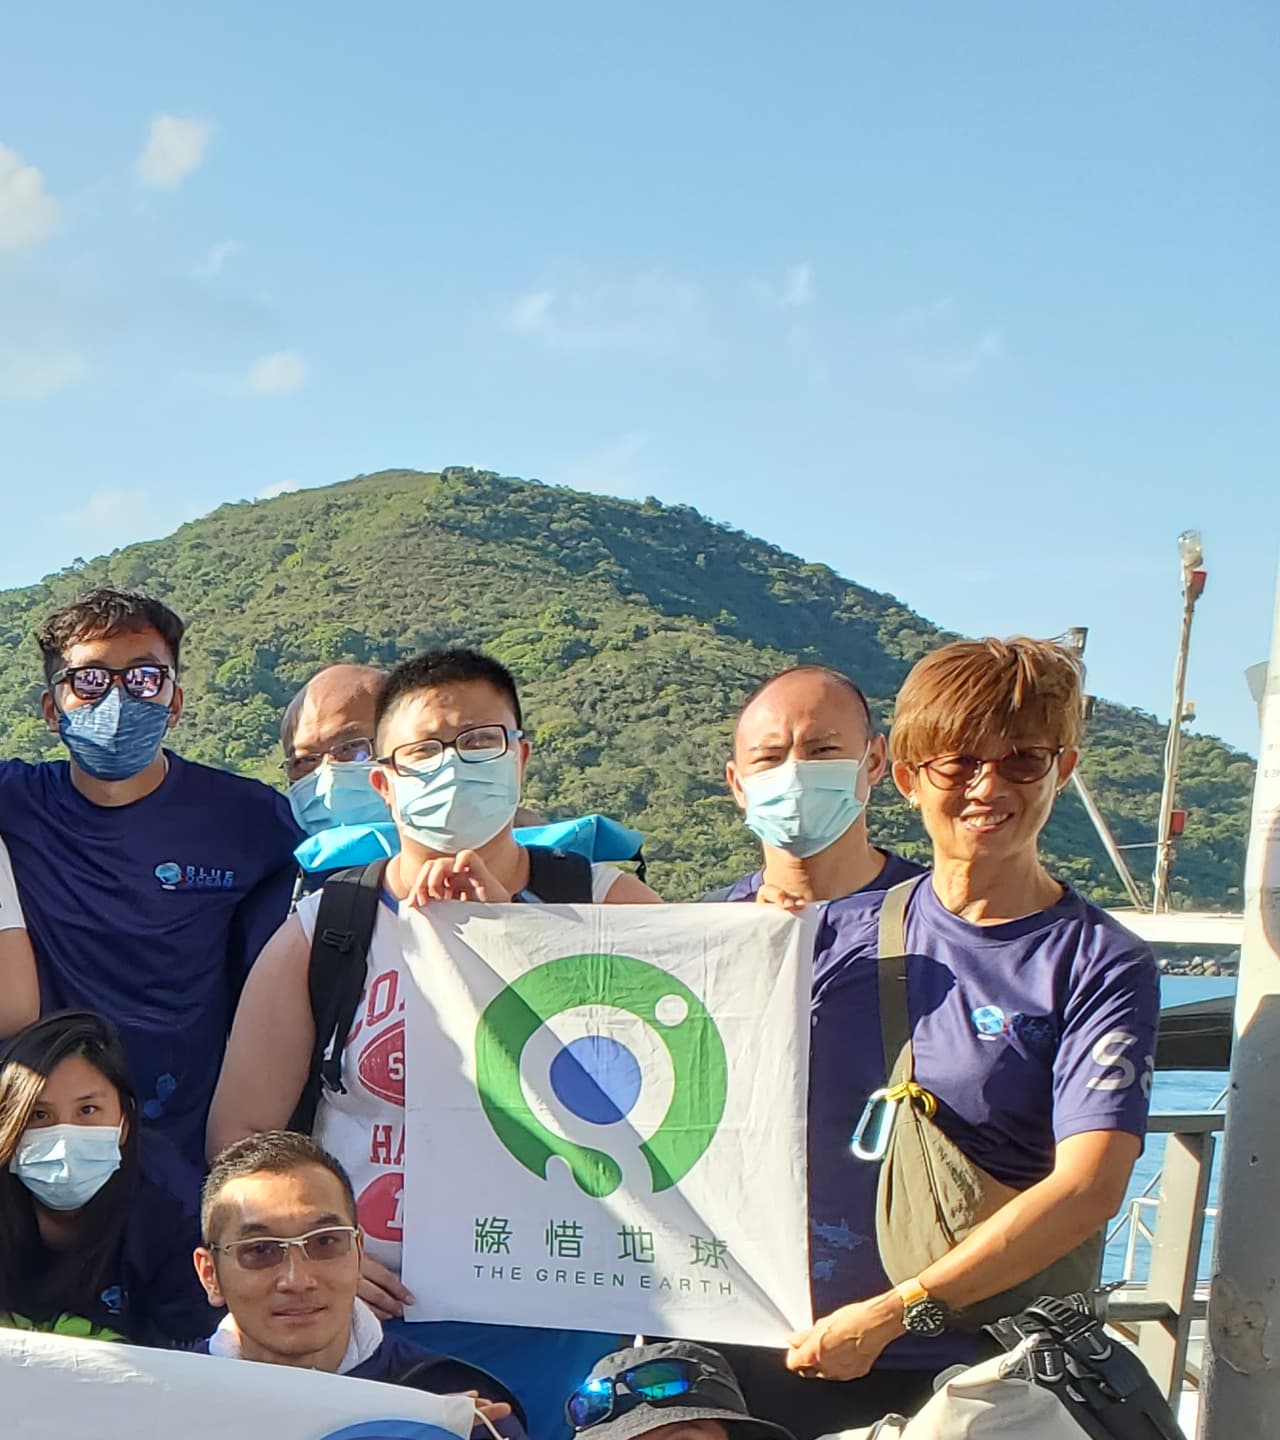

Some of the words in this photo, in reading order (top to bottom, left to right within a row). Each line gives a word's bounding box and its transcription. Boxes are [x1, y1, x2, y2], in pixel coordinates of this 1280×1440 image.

[186, 865, 235, 880] BLUE
[473, 1215, 730, 1271] 綠惜地球
[473, 1264, 522, 1281] THE
[535, 1268, 625, 1289] GREEN
[639, 1275, 732, 1296] EARTH
